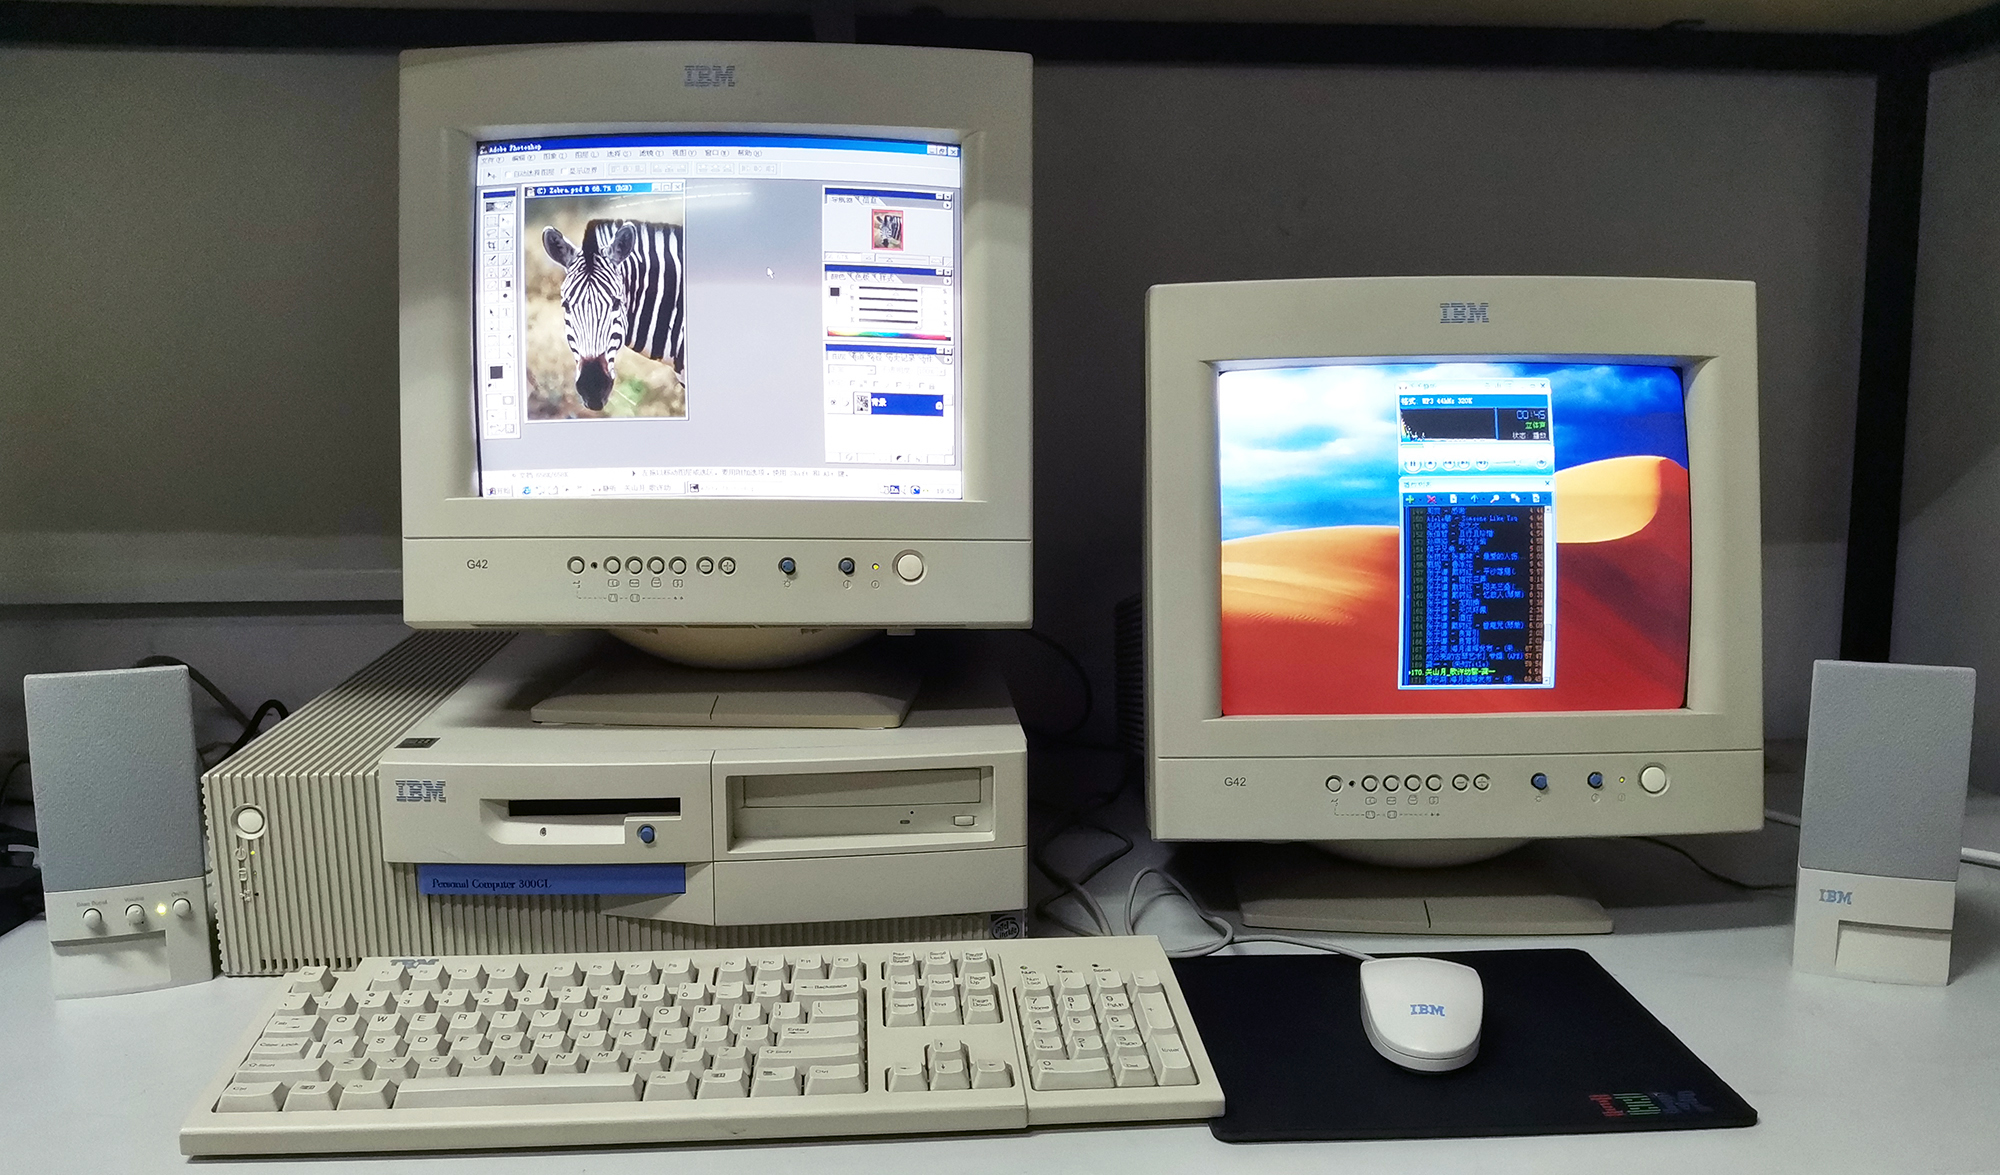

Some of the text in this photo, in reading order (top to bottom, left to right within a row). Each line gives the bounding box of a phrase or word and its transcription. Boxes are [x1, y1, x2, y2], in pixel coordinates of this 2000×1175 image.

[684, 65, 735, 87] IBM
[489, 144, 542, 153] Adobe Photoshop
[1440, 302, 1489, 324] IBM
[1516, 410, 1546, 420] 00:45
[466, 559, 488, 570] G42
[1224, 776, 1246, 788] G42
[395, 780, 446, 803] IBM
[432, 878, 552, 891] Personal Computer 300GL
[1818, 888, 1852, 904] IBM
[1410, 1004, 1446, 1016] IBM
[1588, 1090, 1714, 1117] IBM
